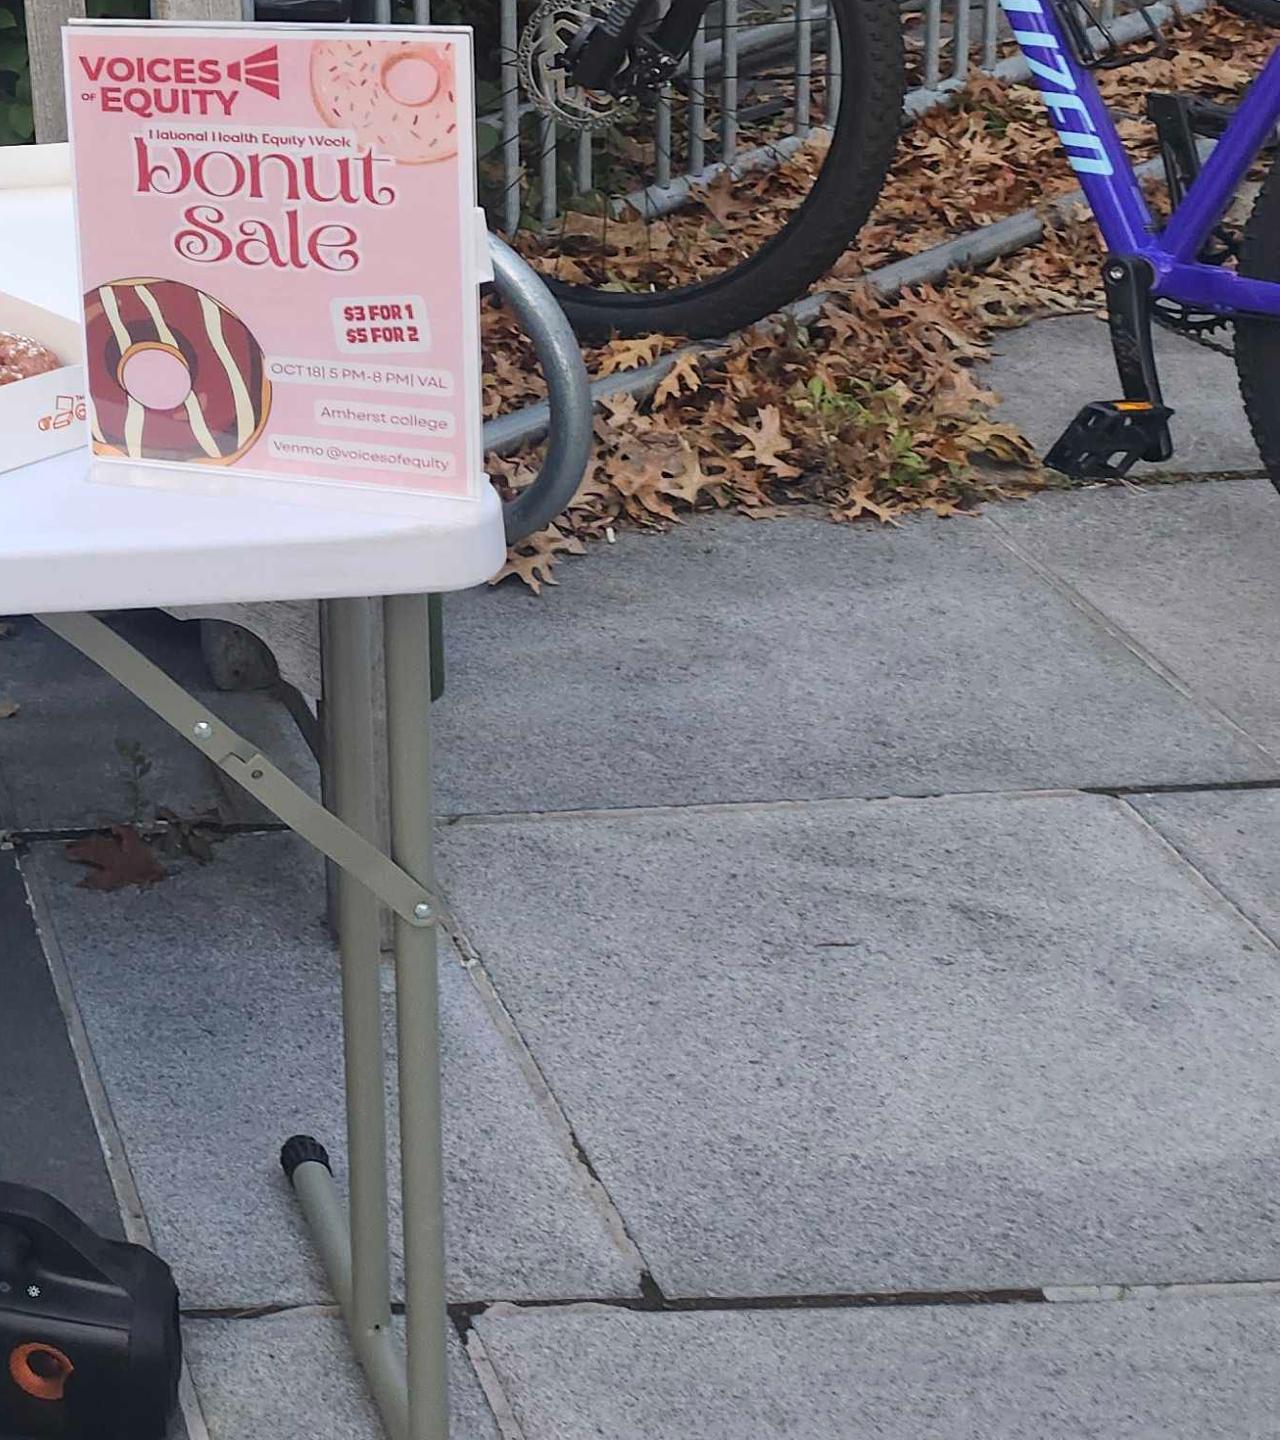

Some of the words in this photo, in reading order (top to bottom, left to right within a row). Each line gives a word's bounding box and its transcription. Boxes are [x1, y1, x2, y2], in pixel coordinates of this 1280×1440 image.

[79, 56, 222, 85] VOICES
[81, 92, 97, 103] OF
[101, 86, 239, 118] EQUITY
[149, 128, 208, 142] National
[212, 130, 258, 144] Health
[262, 133, 305, 148] Equity
[309, 135, 351, 147] Week
[174, 204, 360, 272] Sale
[344, 306, 366, 321] $3
[368, 304, 403, 321] FOR
[405, 304, 414, 320] 1
[346, 328, 369, 343] $5
[370, 327, 405, 343] FOR
[407, 326, 420, 342] 2
[271, 363, 307, 377] OCT
[329, 367, 339, 379] 5
[416, 375, 448, 389] VAL
[320, 406, 387, 424] Amherst
[390, 414, 448, 431] college
[273, 440, 323, 456] Venmo
[326, 446, 449, 471] @voicesofequity
